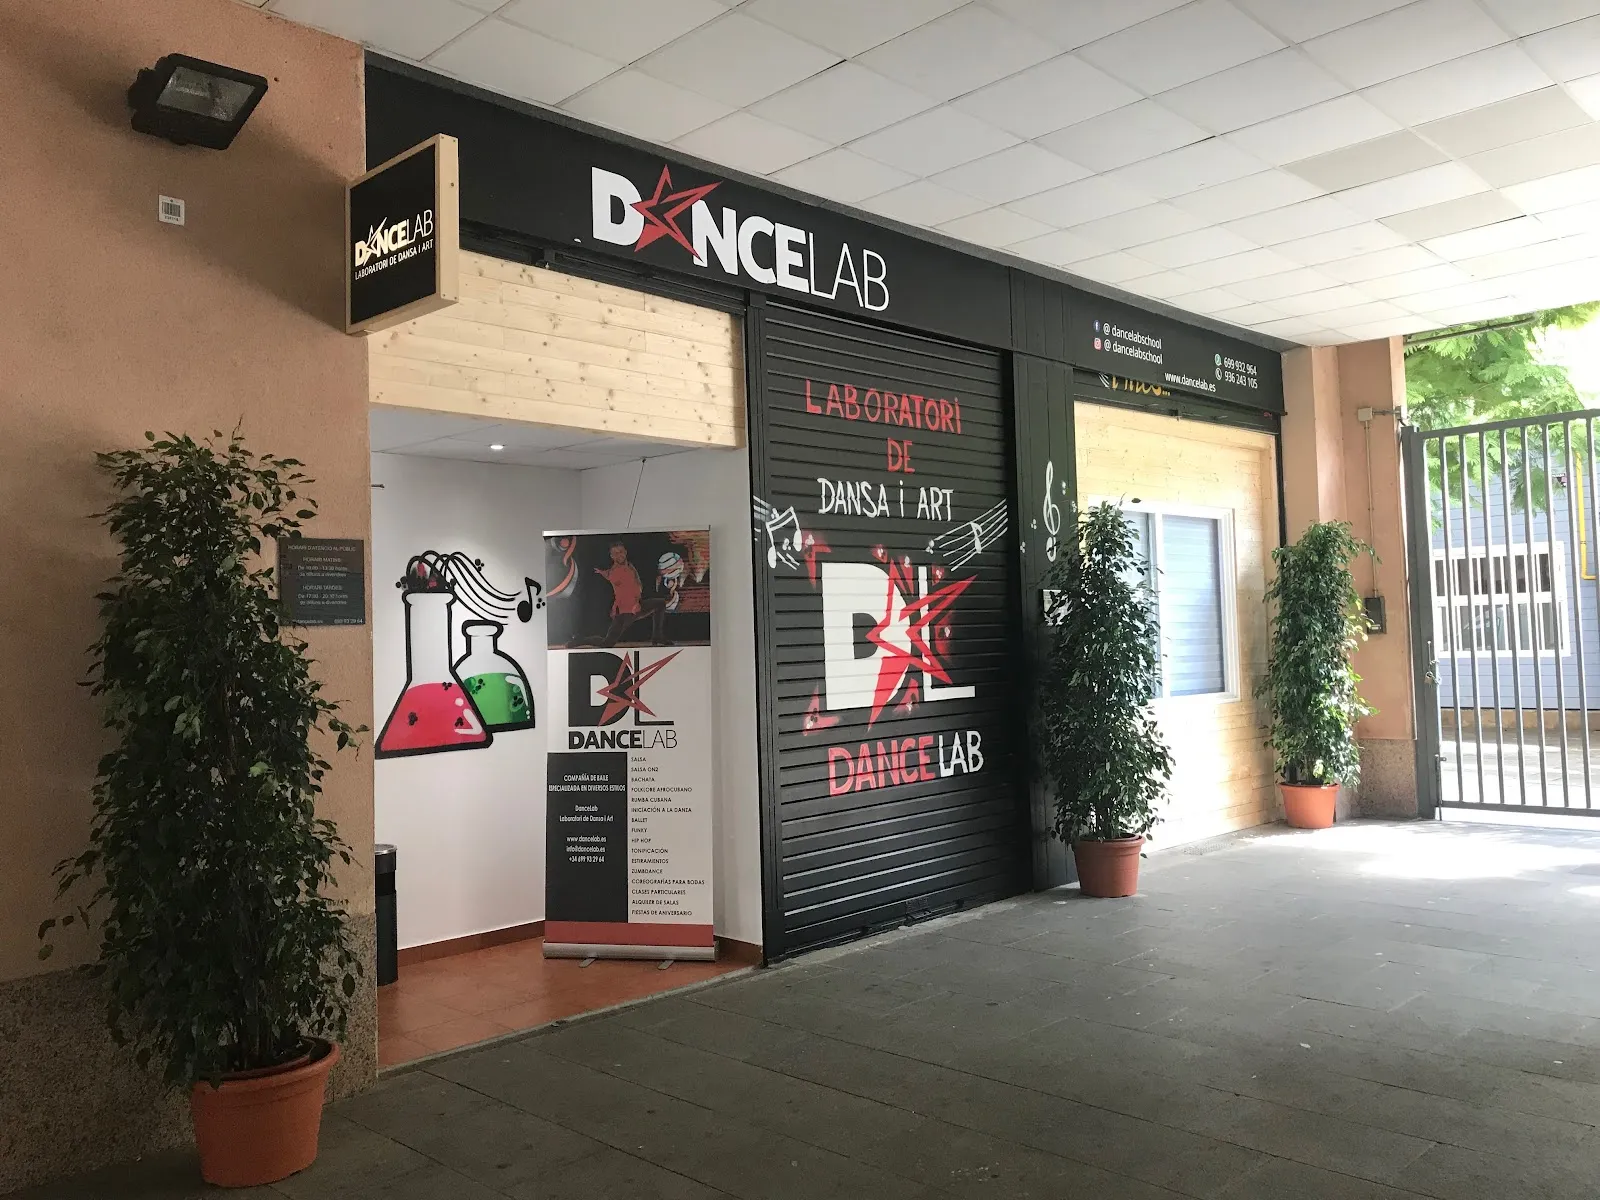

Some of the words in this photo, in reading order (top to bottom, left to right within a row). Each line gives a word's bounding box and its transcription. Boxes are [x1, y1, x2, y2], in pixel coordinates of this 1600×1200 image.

[355, 258, 388, 280] LABORATORI
[389, 255, 397, 266] DE
[398, 246, 417, 262] DANSA
[422, 239, 434, 252] ART
[1112, 325, 1162, 350] dancelabschool
[1112, 340, 1163, 365] dancelabschool
[1164, 372, 1216, 392] www.dancelab.es
[887, 437, 915, 474] DE
[817, 477, 890, 518] DANSA
[917, 486, 954, 521] ART
